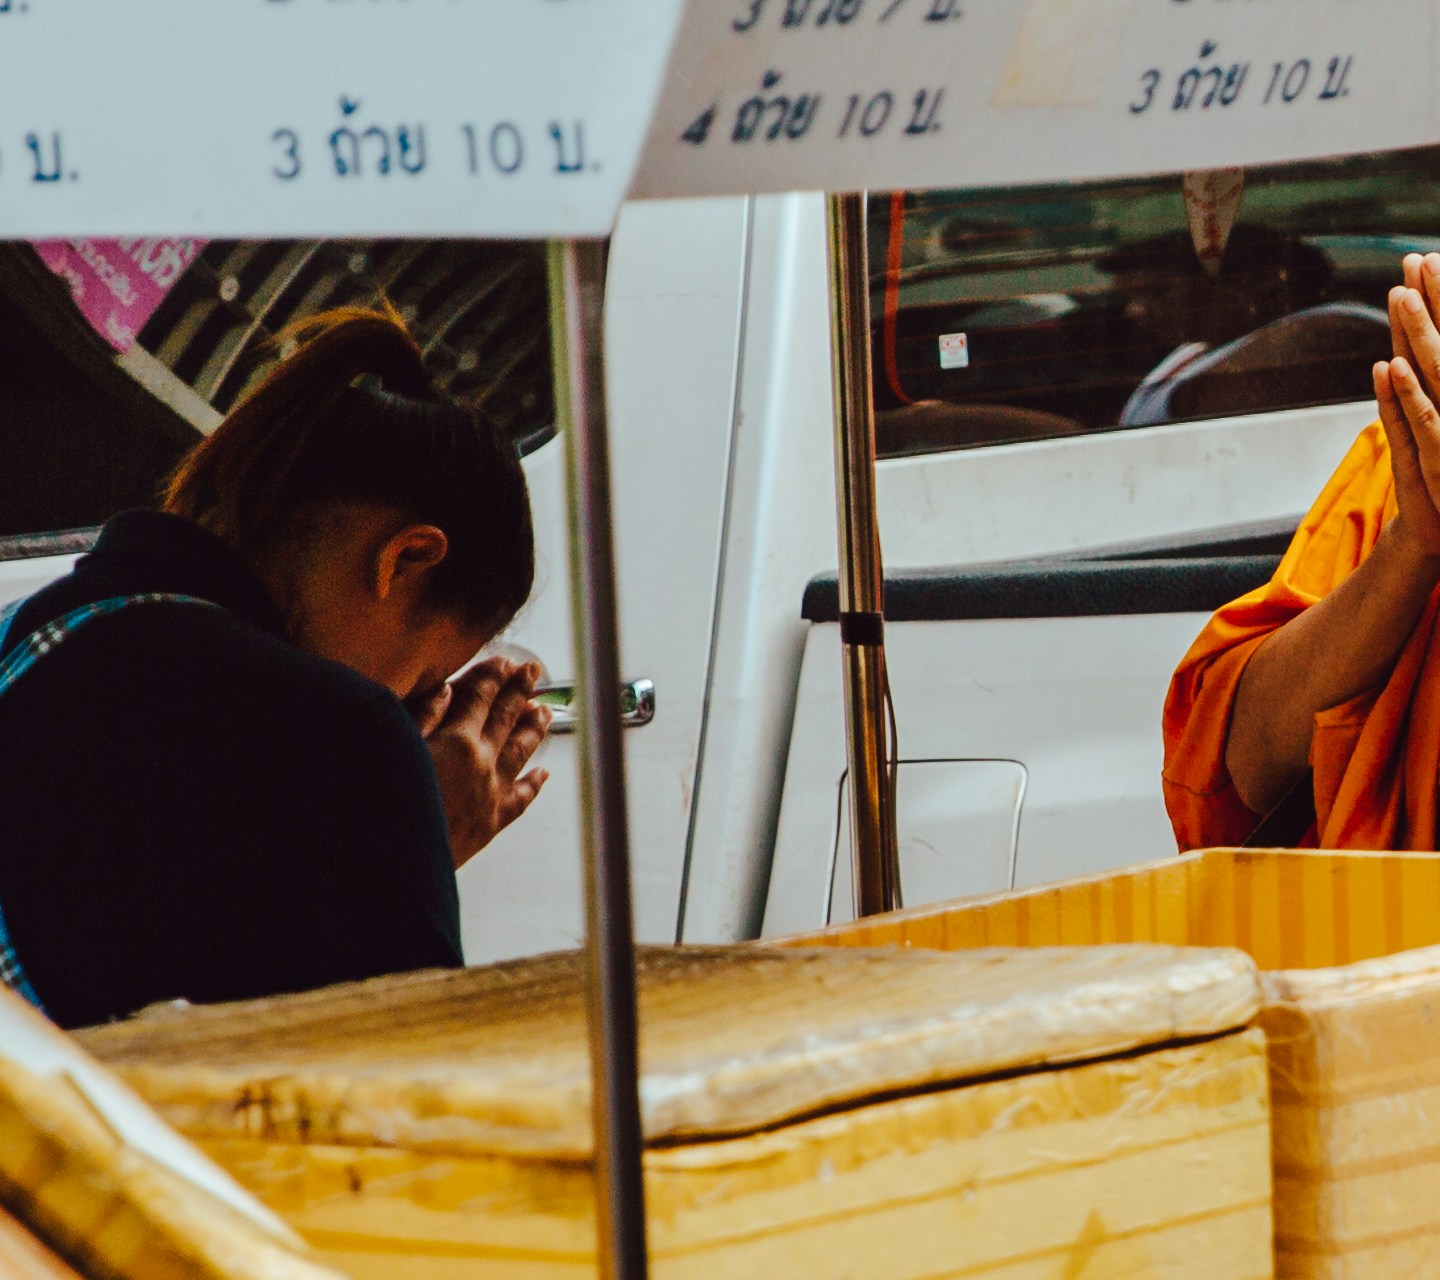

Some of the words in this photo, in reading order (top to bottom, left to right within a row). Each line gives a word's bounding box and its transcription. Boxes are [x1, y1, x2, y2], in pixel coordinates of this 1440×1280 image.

[680, 106, 716, 146] 4
[731, 70, 819, 144] ถ้วย
[838, 90, 895, 138] 10
[904, 88, 941, 136] บ.
[1129, 68, 1162, 115] 3
[1172, 40, 1247, 111] ถ้วย
[1263, 58, 1311, 104] 10
[1318, 57, 1350, 101] บ.
[26, 134, 79, 183] บ.
[272, 128, 302, 181] 3
[328, 99, 425, 177] ถ้วย
[461, 121, 524, 176] 10
[549, 123, 602, 174] บ.
